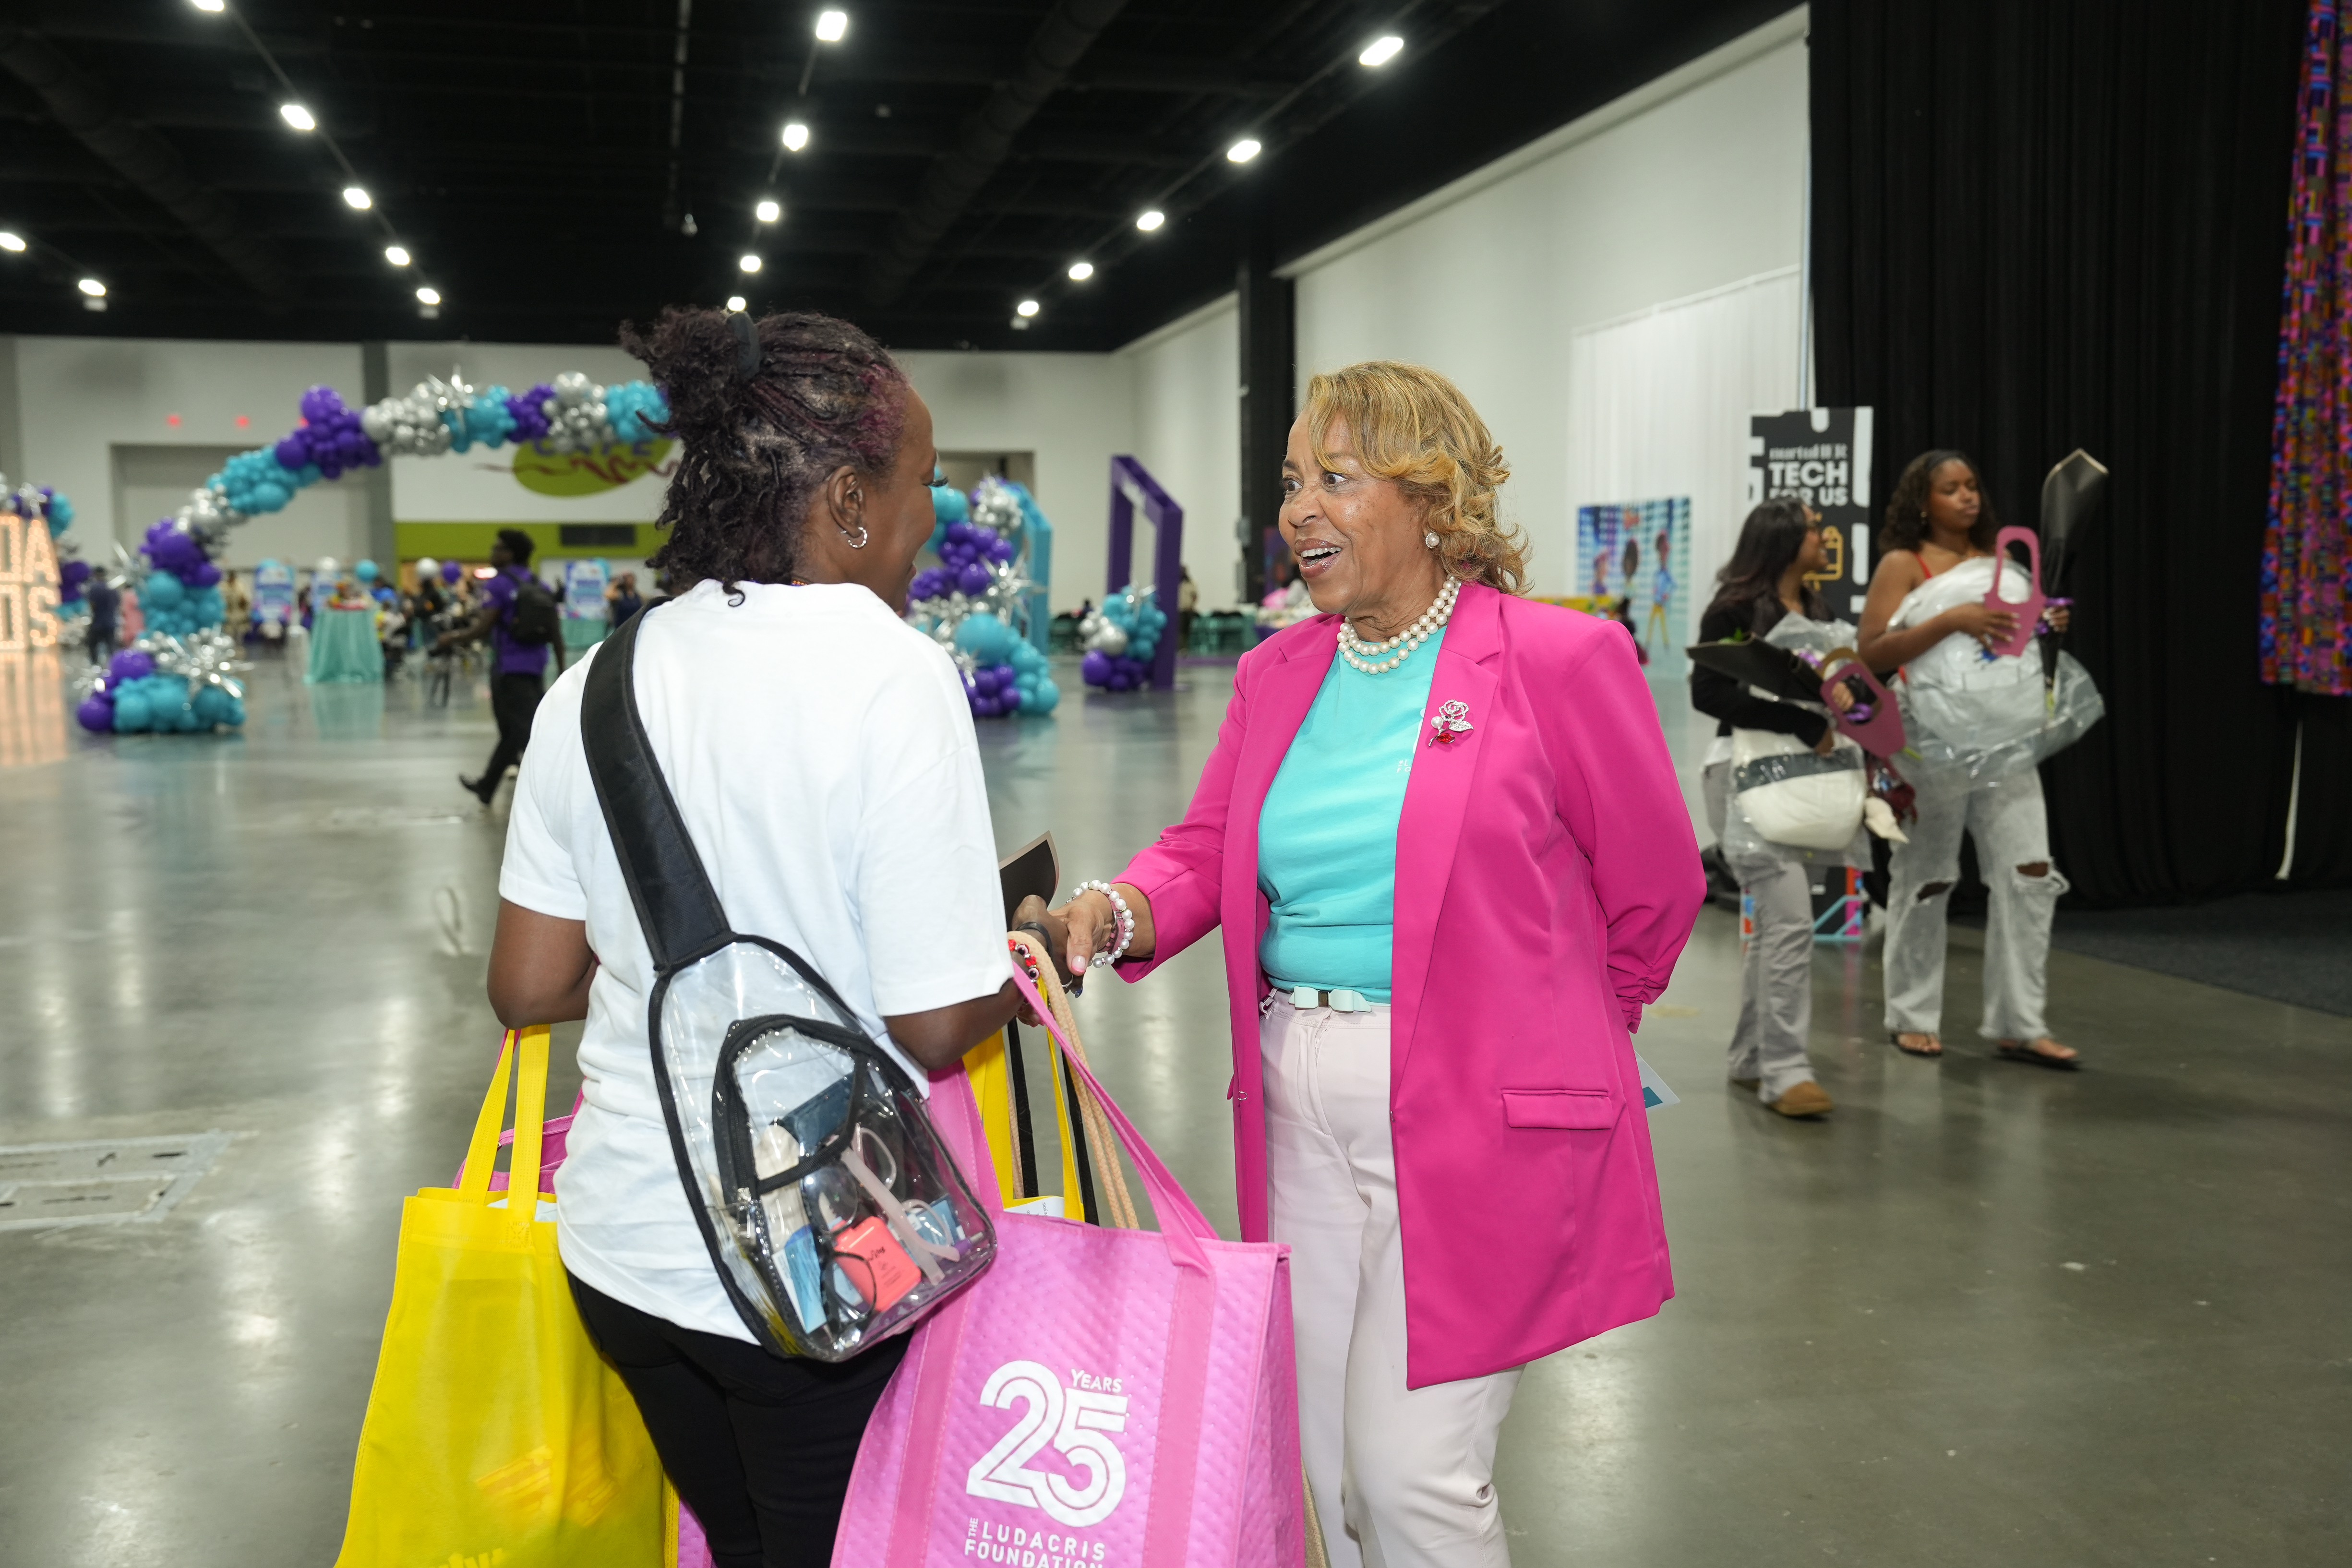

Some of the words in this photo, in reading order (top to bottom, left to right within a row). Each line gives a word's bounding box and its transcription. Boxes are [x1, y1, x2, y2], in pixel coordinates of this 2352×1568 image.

[1768, 460, 1848, 487] TECH
[1819, 486, 1849, 507] US
[1071, 1369, 1123, 1393] YEARS
[966, 1360, 1128, 1528] 25
[968, 1517, 979, 1537] THE
[982, 1521, 1105, 1561] LUDACRIS
